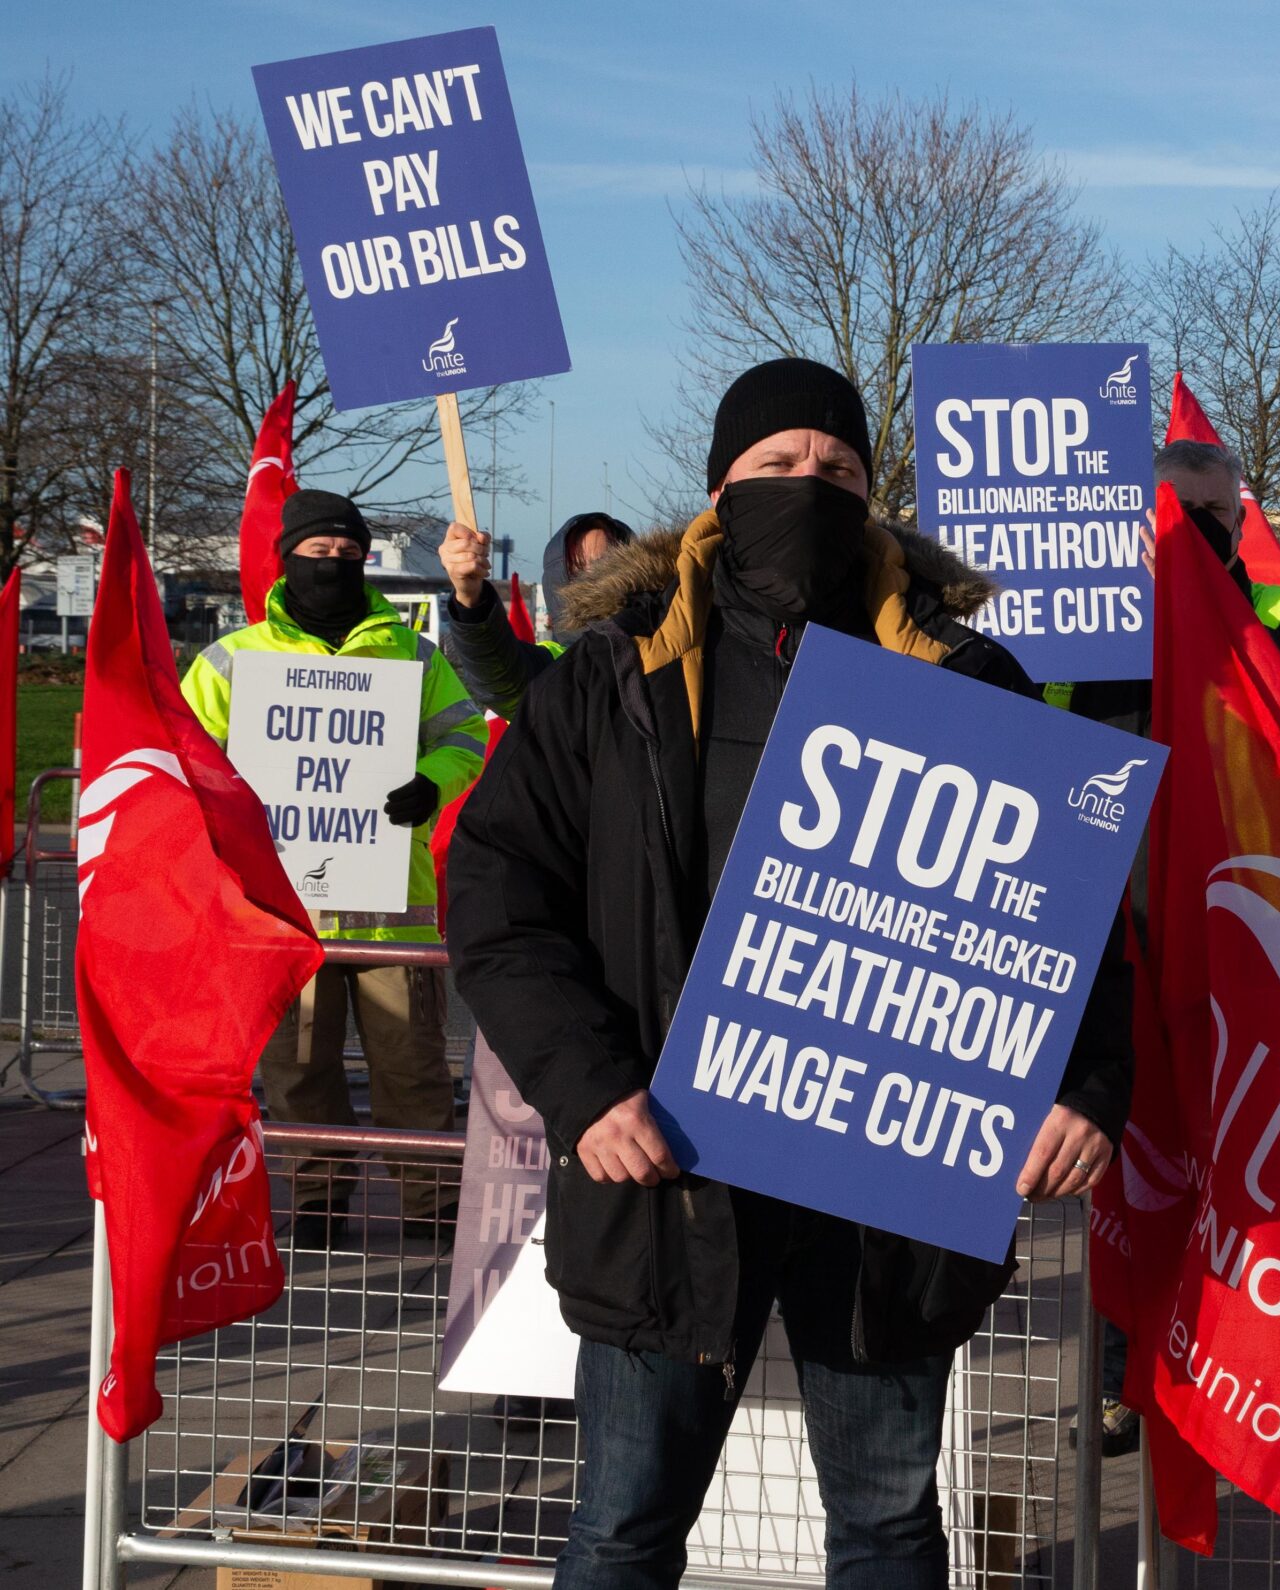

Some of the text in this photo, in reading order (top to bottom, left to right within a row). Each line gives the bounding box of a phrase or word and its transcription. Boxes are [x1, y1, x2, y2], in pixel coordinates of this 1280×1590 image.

[286, 64, 482, 150] WE CAN'T
[363, 150, 441, 216] PAY
[321, 215, 526, 299] OUR BILLS
[936, 397, 1108, 478] STOP THE
[938, 485, 1142, 514] BILLIONAIRE-BACKED
[939, 521, 1140, 571] HEATHROW
[966, 586, 1143, 636] AGE CUTS
[286, 668, 372, 692] HEATHROW
[266, 704, 385, 746] CUT OUR
[296, 756, 350, 793] PAY
[308, 806, 378, 844] WAY!
[779, 724, 1047, 922] STOP THE
[753, 856, 1077, 995] BILLIONAIRE-BACKED
[721, 913, 1054, 1079] HEATHROW
[693, 1015, 1015, 1178] WAGE CUTS
